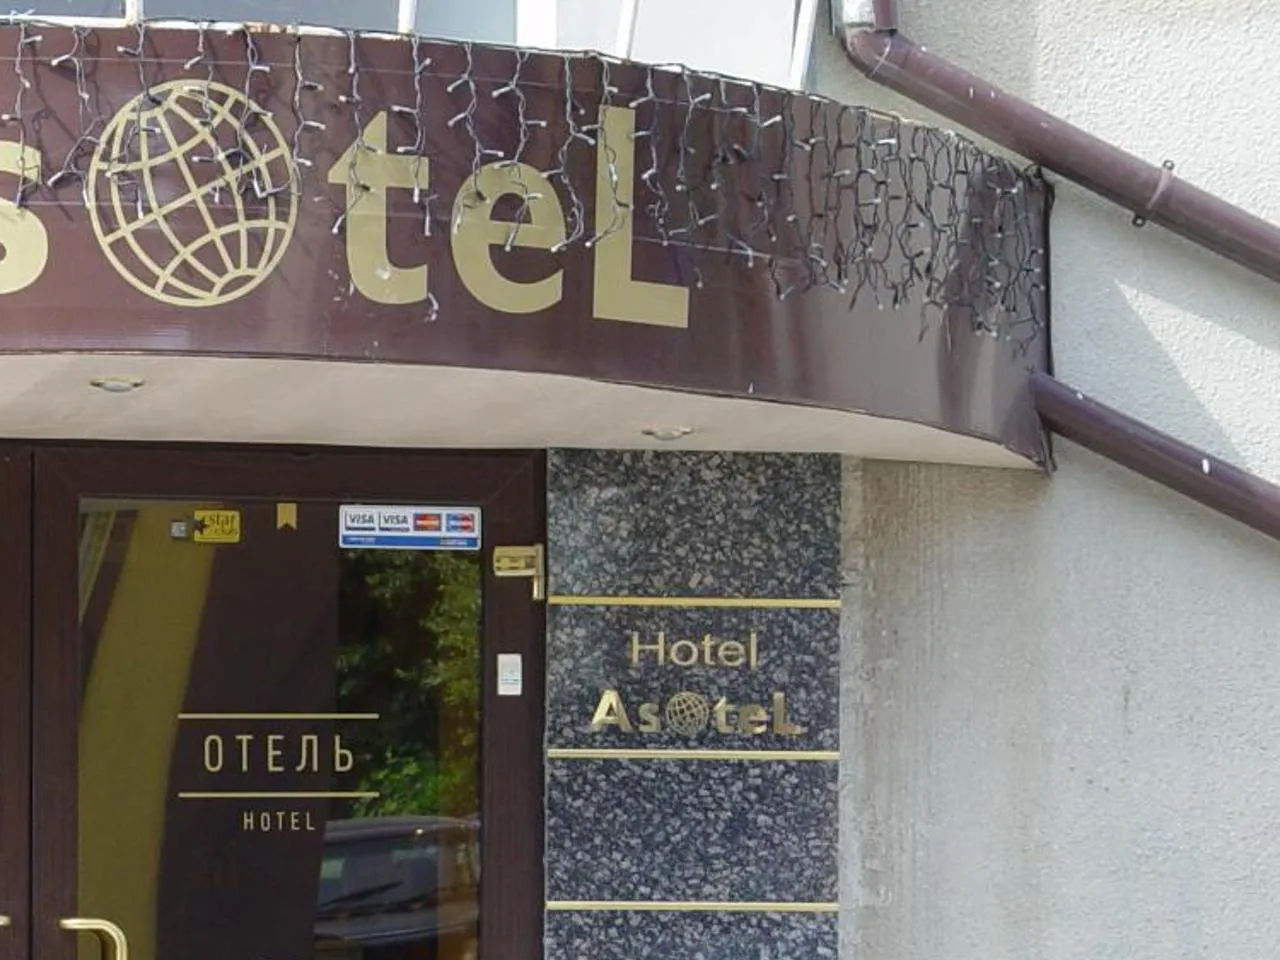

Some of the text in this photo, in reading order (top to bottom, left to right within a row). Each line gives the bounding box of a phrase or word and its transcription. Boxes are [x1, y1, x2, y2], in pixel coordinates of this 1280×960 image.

[349, 513, 375, 525] VISA
[383, 513, 409, 525] VISA
[631, 631, 757, 669] Hotel
[204, 735, 354, 773] ОТЕЛЬ
[243, 811, 316, 832] HOTEL
